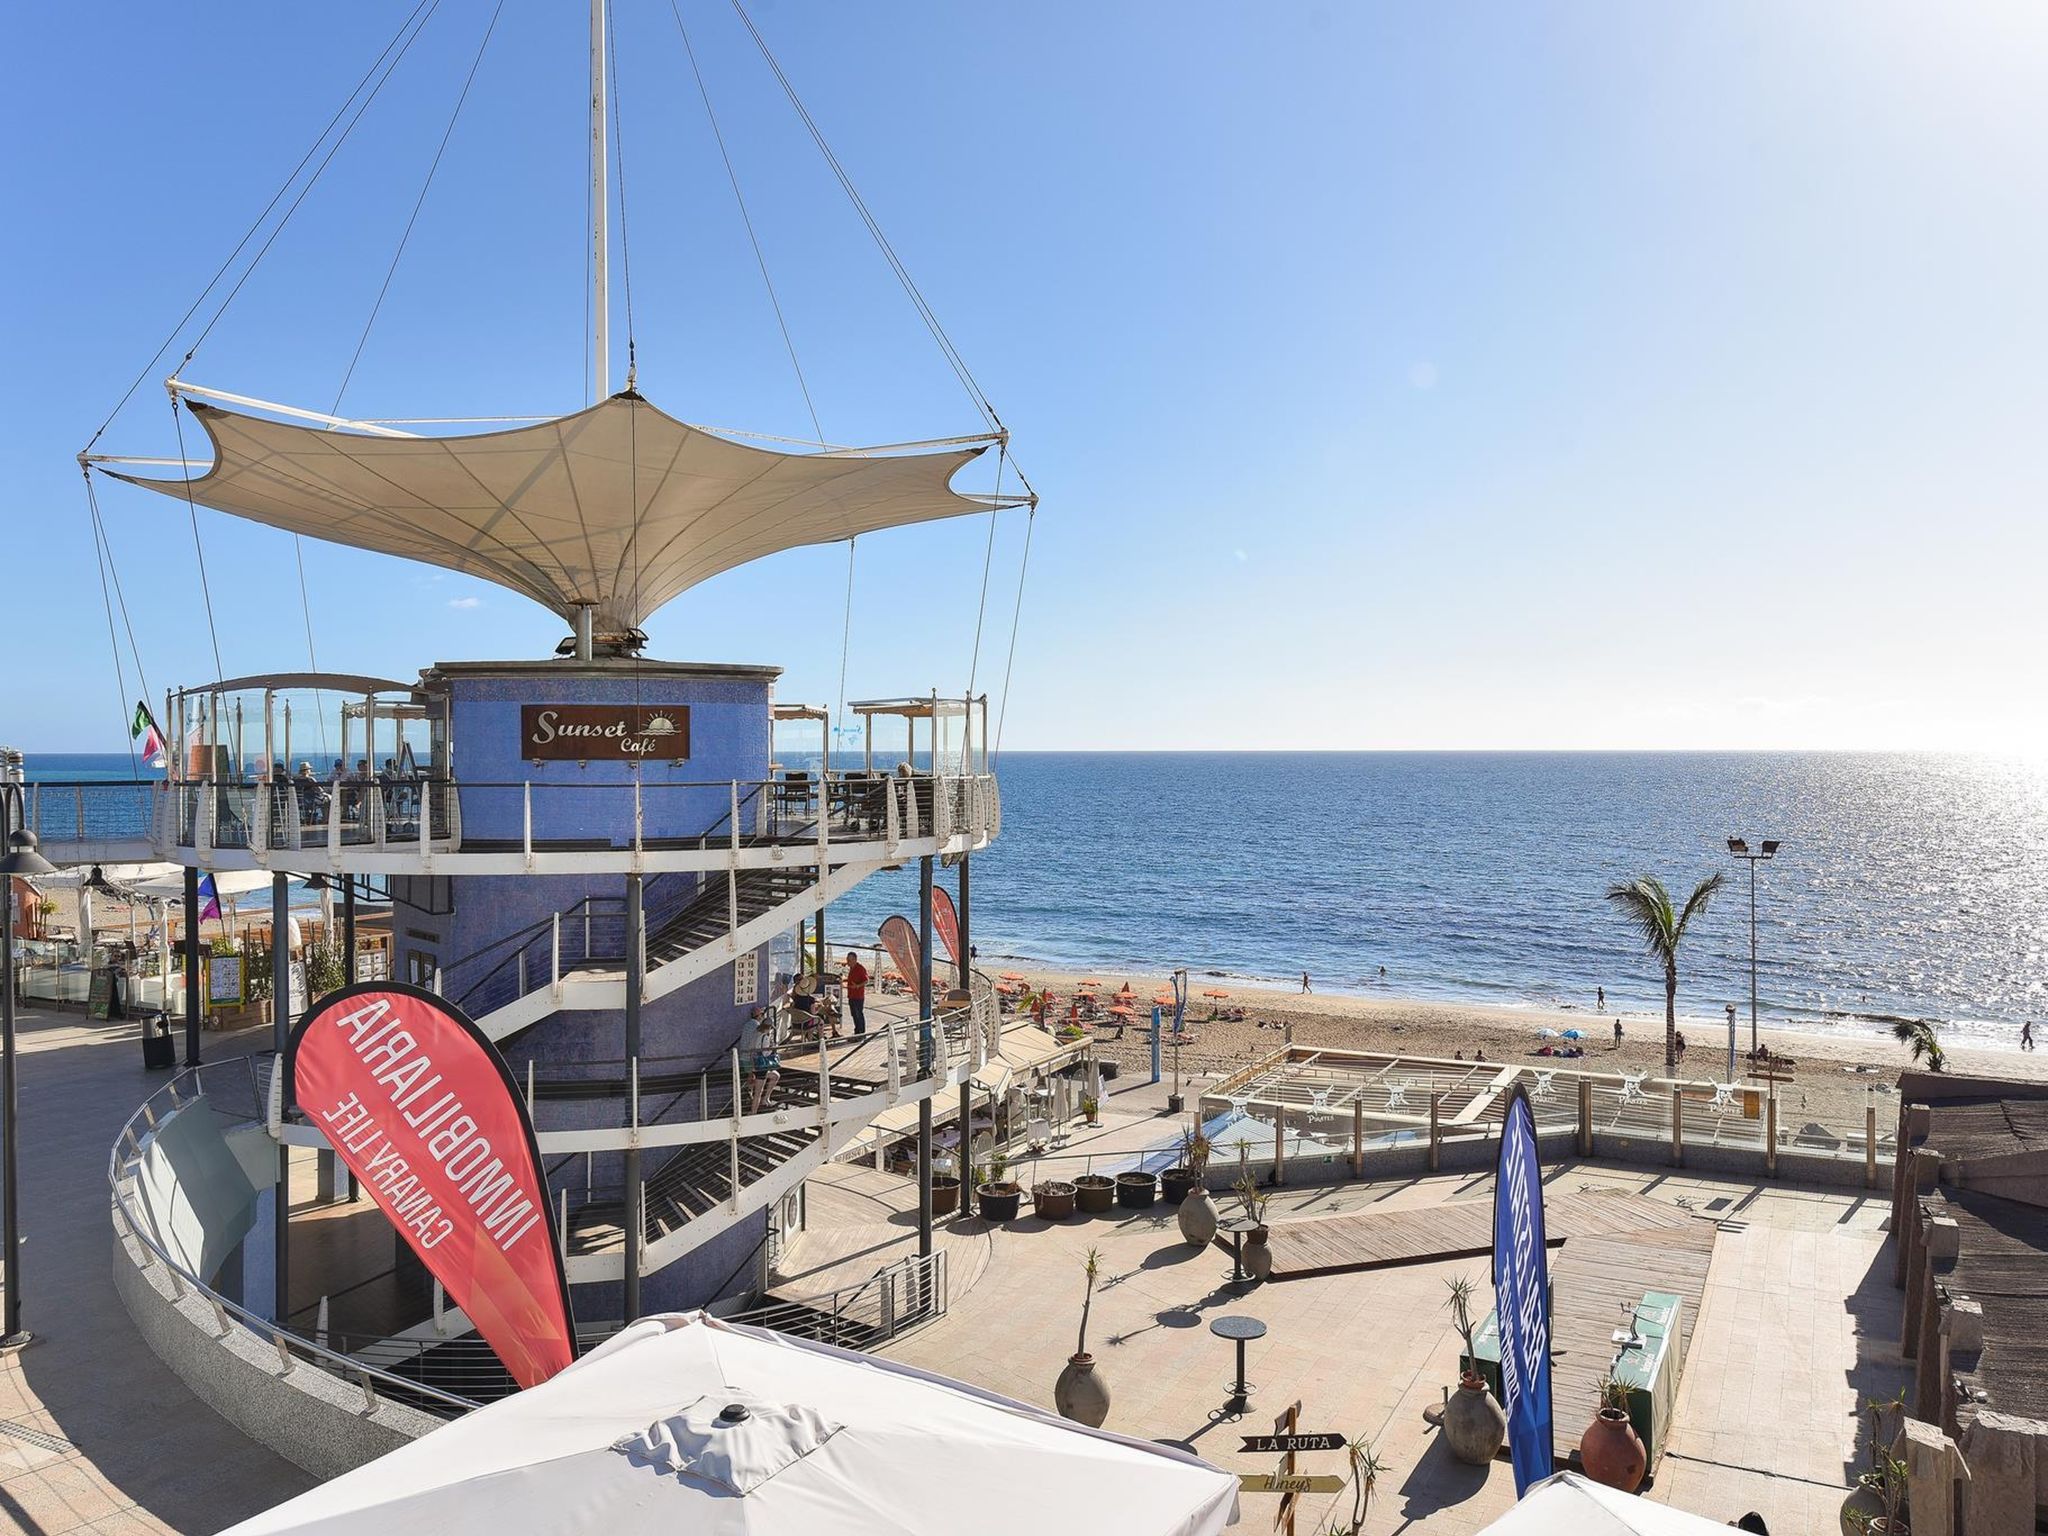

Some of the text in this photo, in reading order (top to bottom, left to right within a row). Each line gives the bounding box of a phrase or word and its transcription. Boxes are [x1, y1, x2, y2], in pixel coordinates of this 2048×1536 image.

[532, 711, 628, 744] Sunset
[620, 737, 656, 756] Café
[1256, 1436, 1331, 1451] LA RUTA
